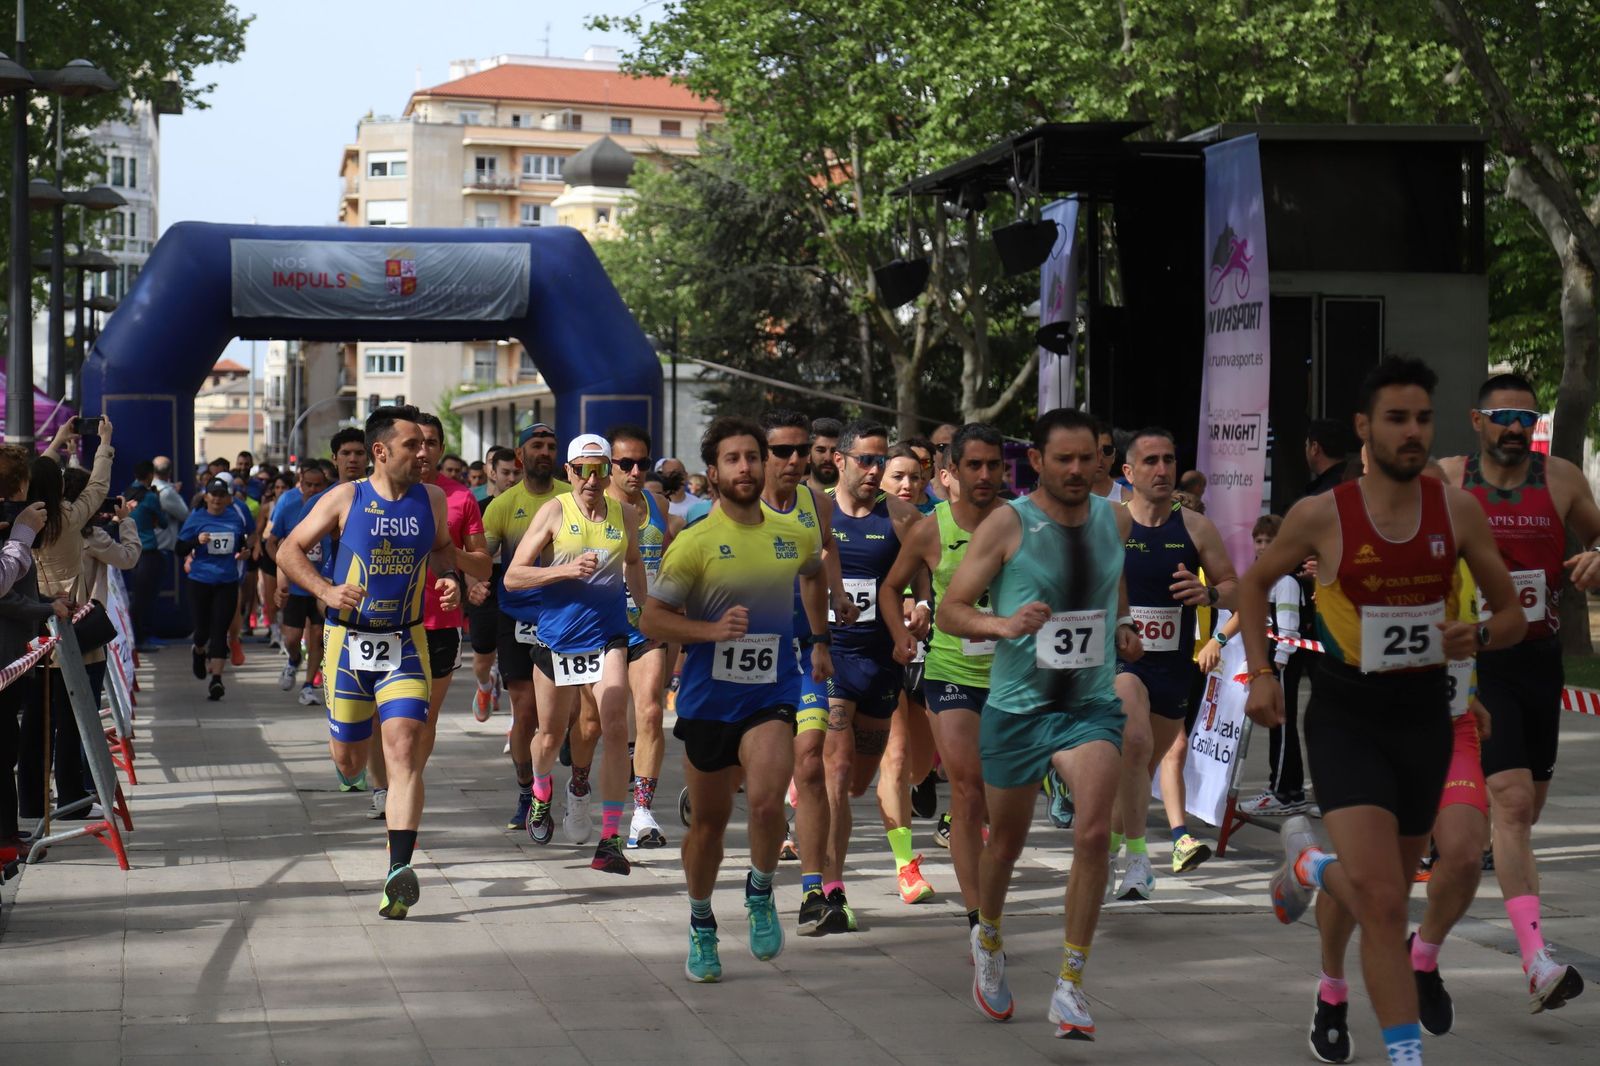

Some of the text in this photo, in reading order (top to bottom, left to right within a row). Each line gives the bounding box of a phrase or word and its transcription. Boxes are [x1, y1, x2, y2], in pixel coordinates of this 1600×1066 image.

[272, 257, 307, 269] NOS
[1222, 424, 1257, 441] NIGHT
[370, 516, 420, 537] JESUS
[1518, 515, 1550, 527] DURI
[213, 538, 229, 549] 87
[776, 552, 798, 560] DUERO
[369, 564, 414, 575] DUERO
[1054, 627, 1093, 655] 37
[1384, 624, 1430, 656] 25
[360, 640, 390, 660] 92
[559, 655, 600, 676] 185
[722, 647, 773, 672] 156
[939, 694, 967, 702] Adarsa
